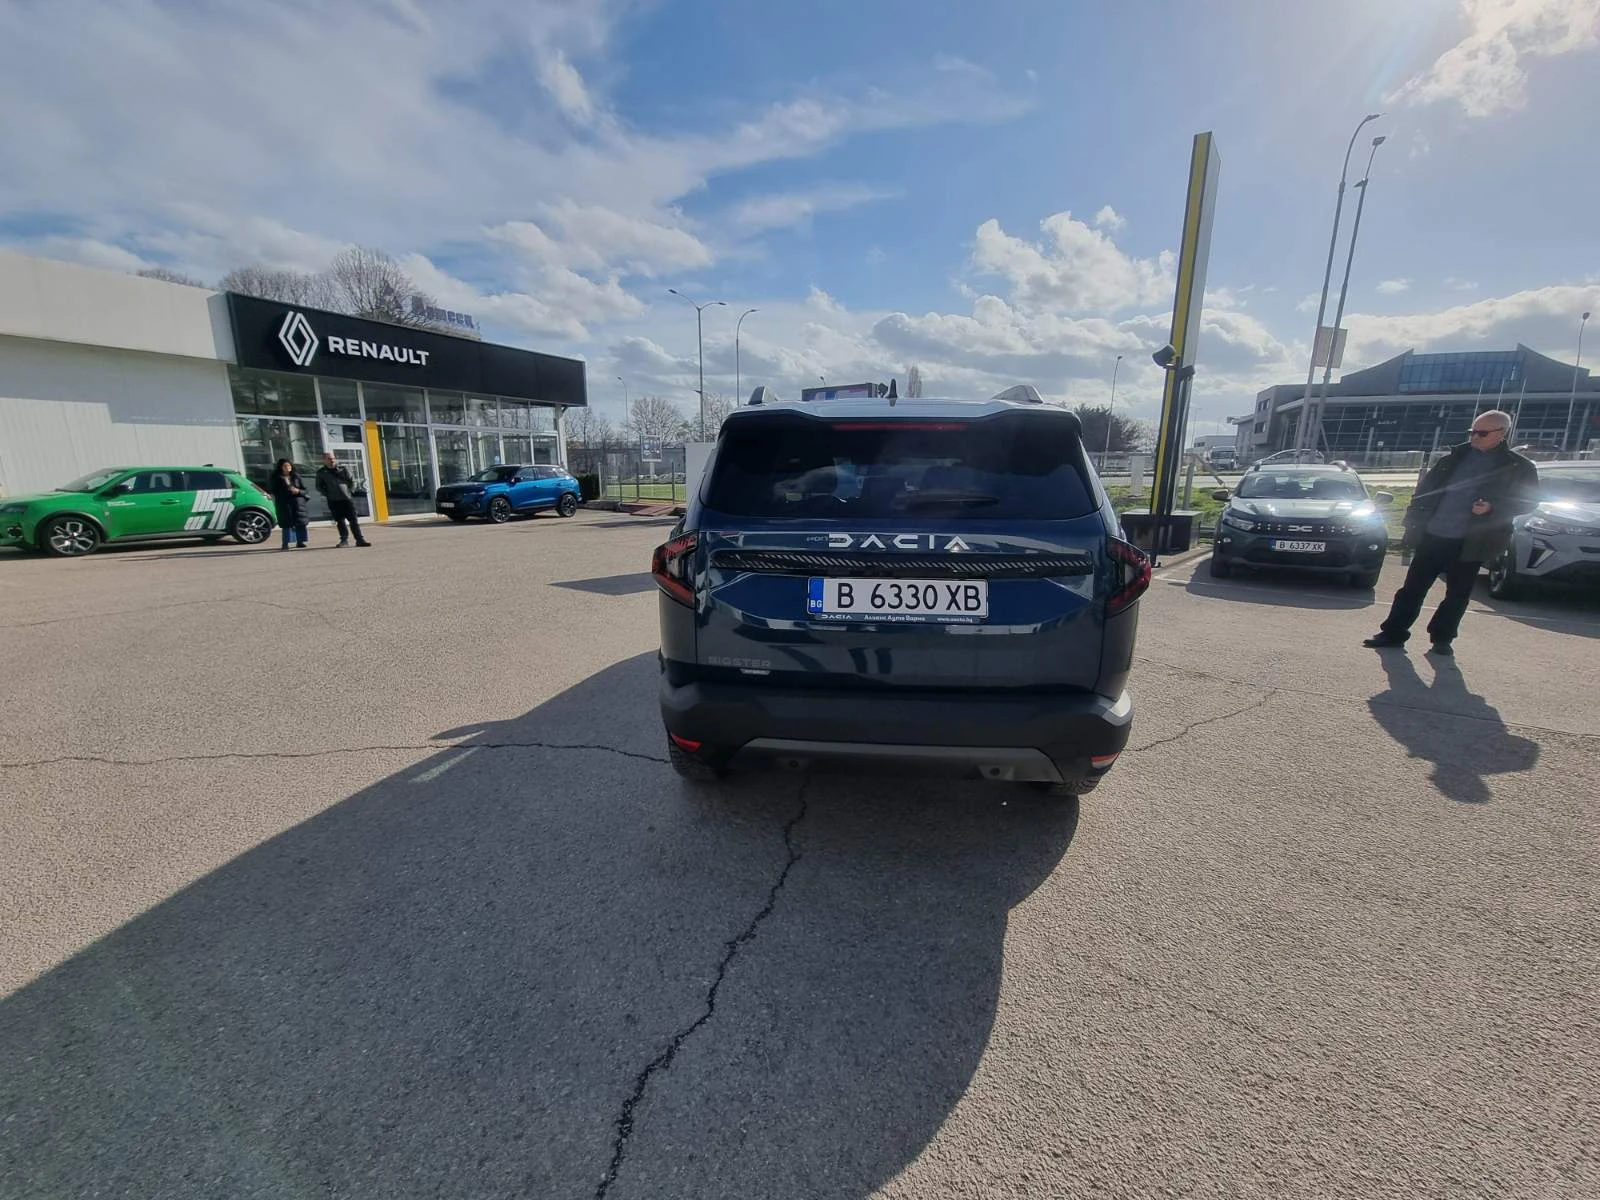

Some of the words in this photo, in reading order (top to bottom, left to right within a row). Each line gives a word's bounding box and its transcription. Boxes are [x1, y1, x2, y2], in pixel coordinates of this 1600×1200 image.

[327, 335, 430, 366] RENAULT
[828, 533, 971, 551] DACIA
[810, 600, 823, 608] BG
[836, 582, 855, 609] B
[869, 583, 939, 610] 6330
[945, 584, 982, 612] XB
